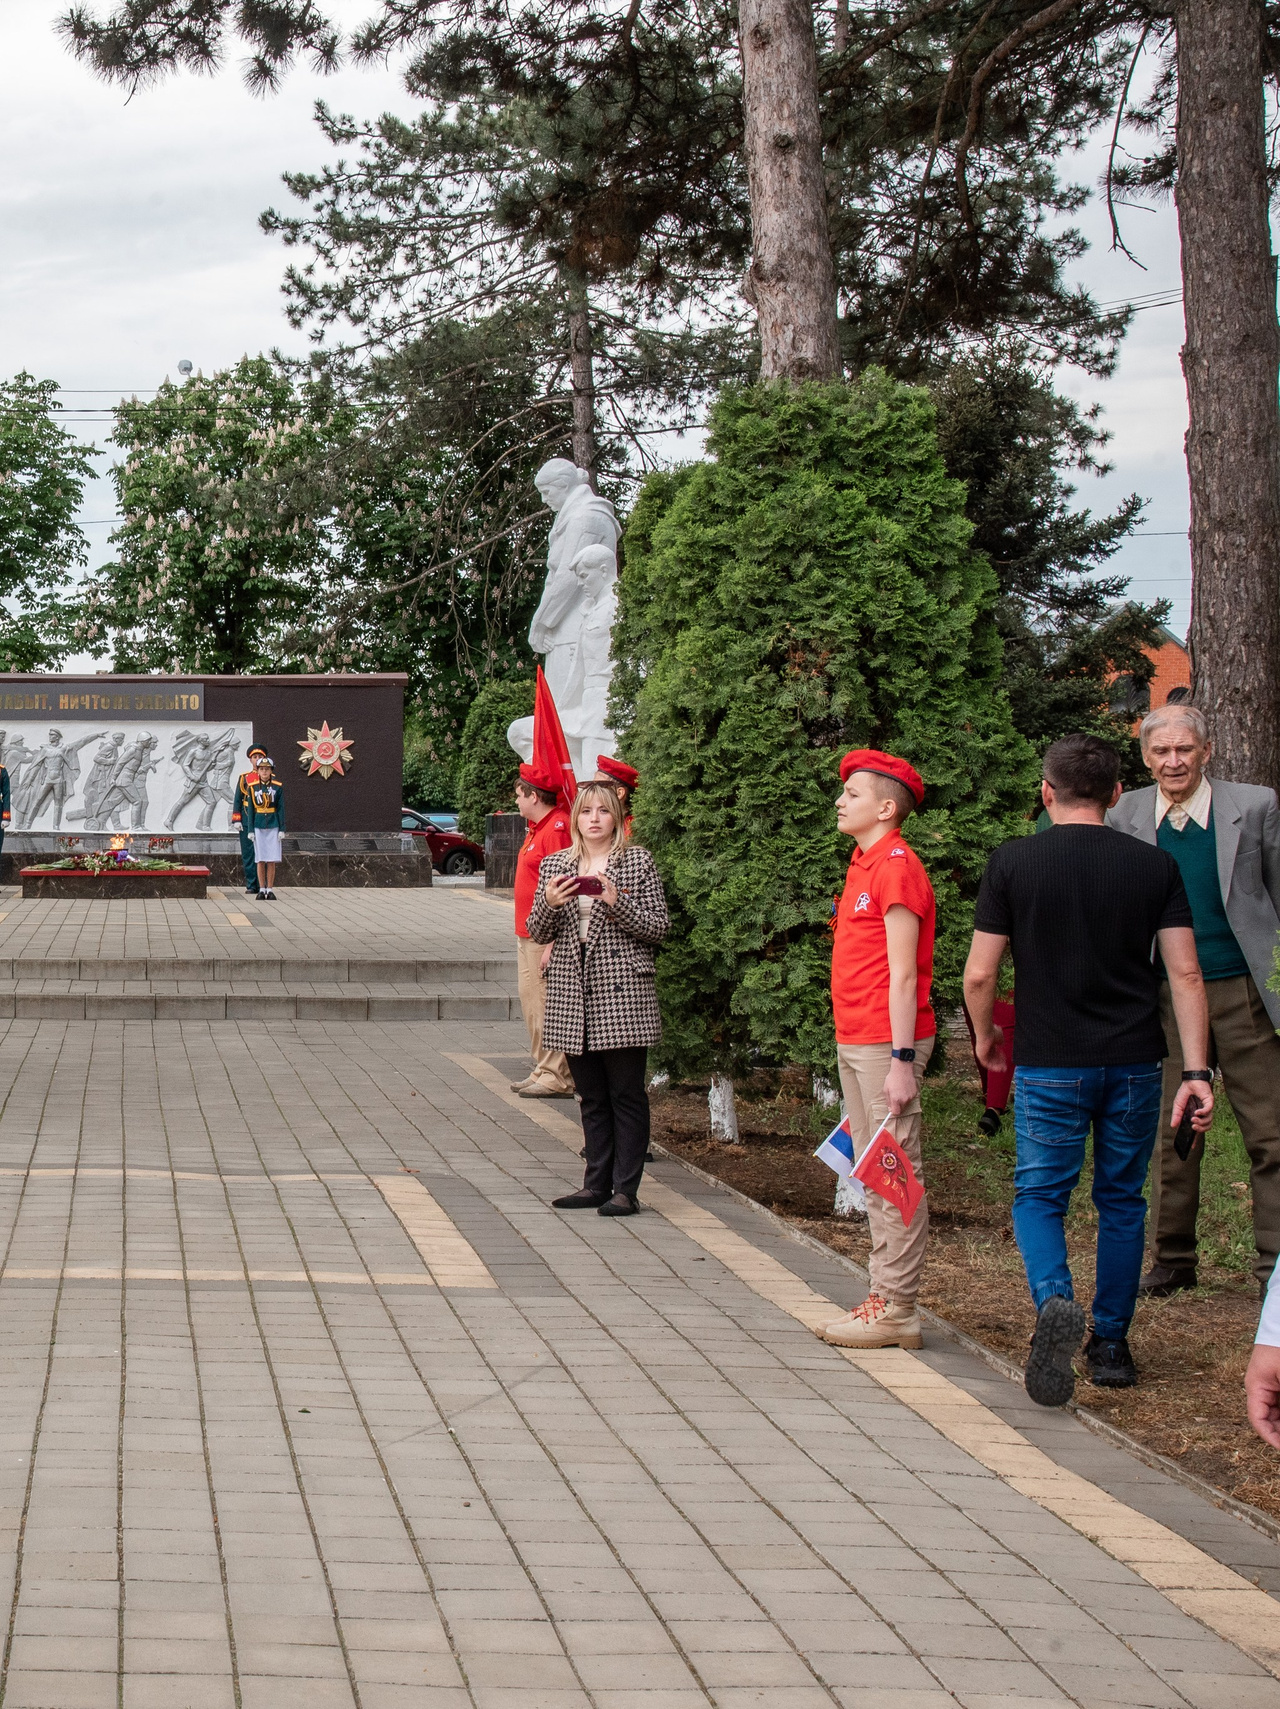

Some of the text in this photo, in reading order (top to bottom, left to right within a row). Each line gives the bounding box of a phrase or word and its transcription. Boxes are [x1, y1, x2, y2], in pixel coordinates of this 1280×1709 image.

[59, 694, 110, 710] НИЧТО
[113, 694, 131, 710] НЕ
[135, 694, 200, 710] ЗАБЫТО
